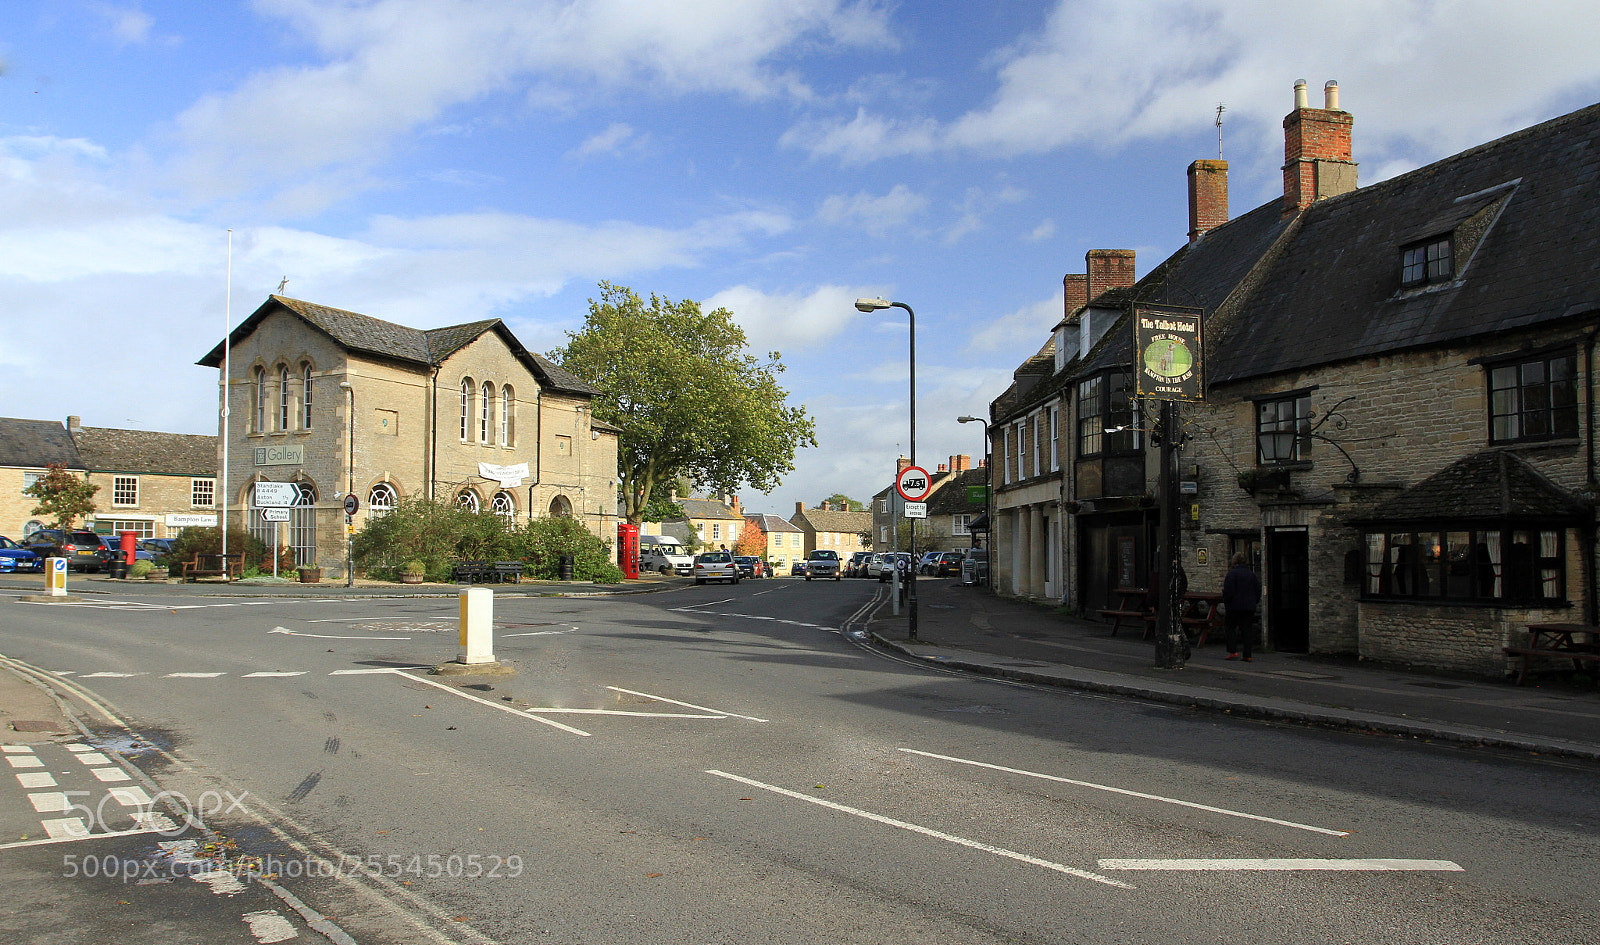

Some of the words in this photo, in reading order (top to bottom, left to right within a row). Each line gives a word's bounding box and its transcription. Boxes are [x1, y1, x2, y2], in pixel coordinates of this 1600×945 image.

[1141, 318, 1154, 329] The
[1155, 319, 1177, 331] Talbot
[1177, 321, 1195, 332] Hotel
[1151, 334, 1166, 342] FREE
[1168, 334, 1186, 345] HOUSE
[268, 447, 301, 463] Gallery
